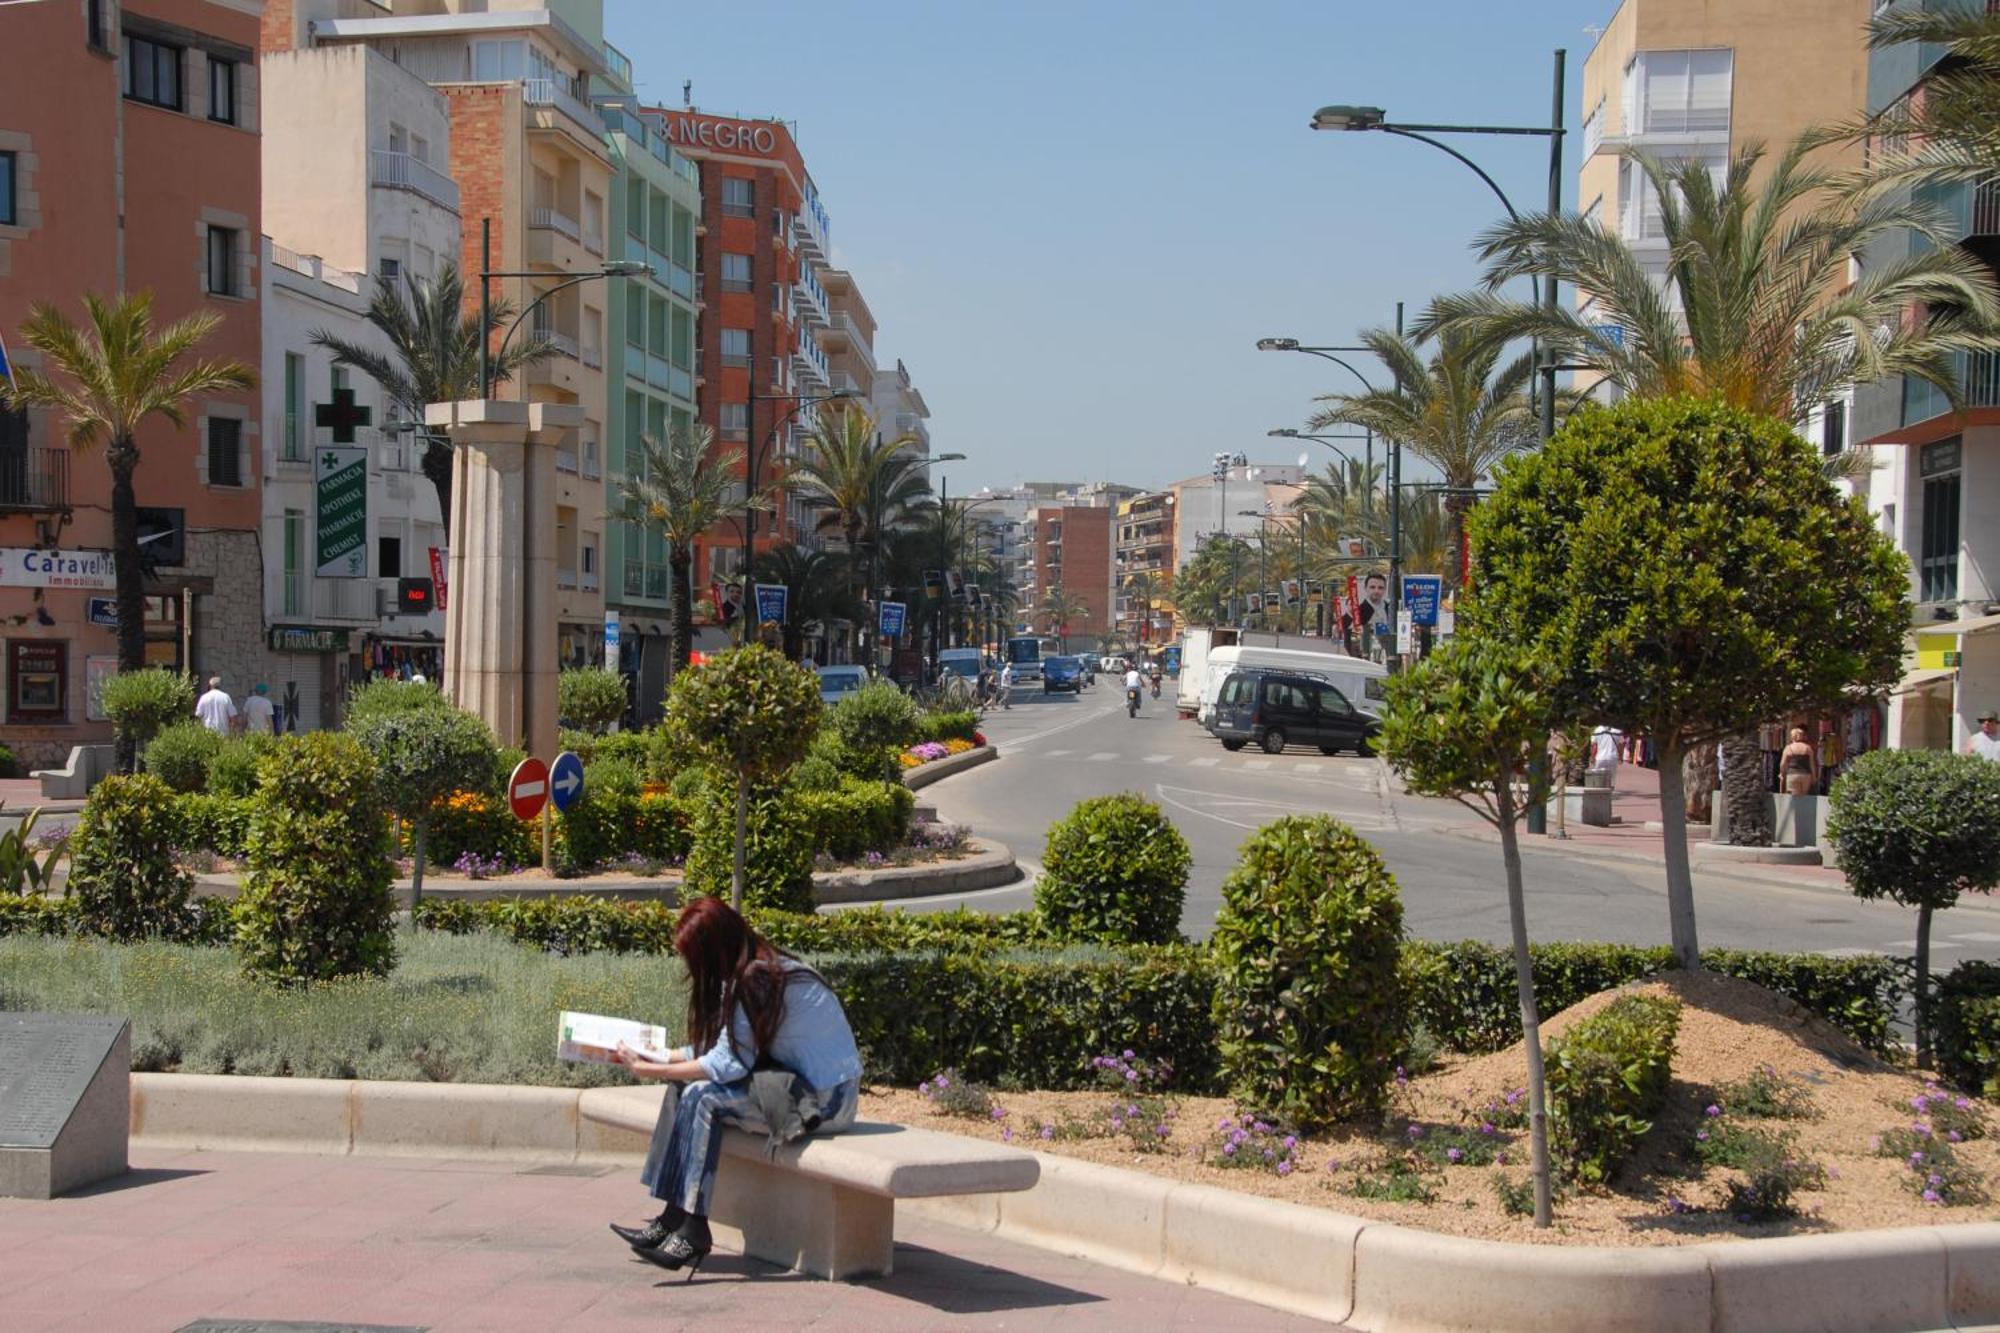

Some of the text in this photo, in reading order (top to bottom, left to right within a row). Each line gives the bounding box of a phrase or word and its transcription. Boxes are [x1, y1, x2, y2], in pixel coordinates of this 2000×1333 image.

[679, 117, 775, 154] NEGRO
[320, 466, 364, 493] FARMACIA
[318, 508, 365, 540] PHARMACIE
[323, 533, 361, 558] CHEMIST
[284, 631, 332, 649] FARMACIA
